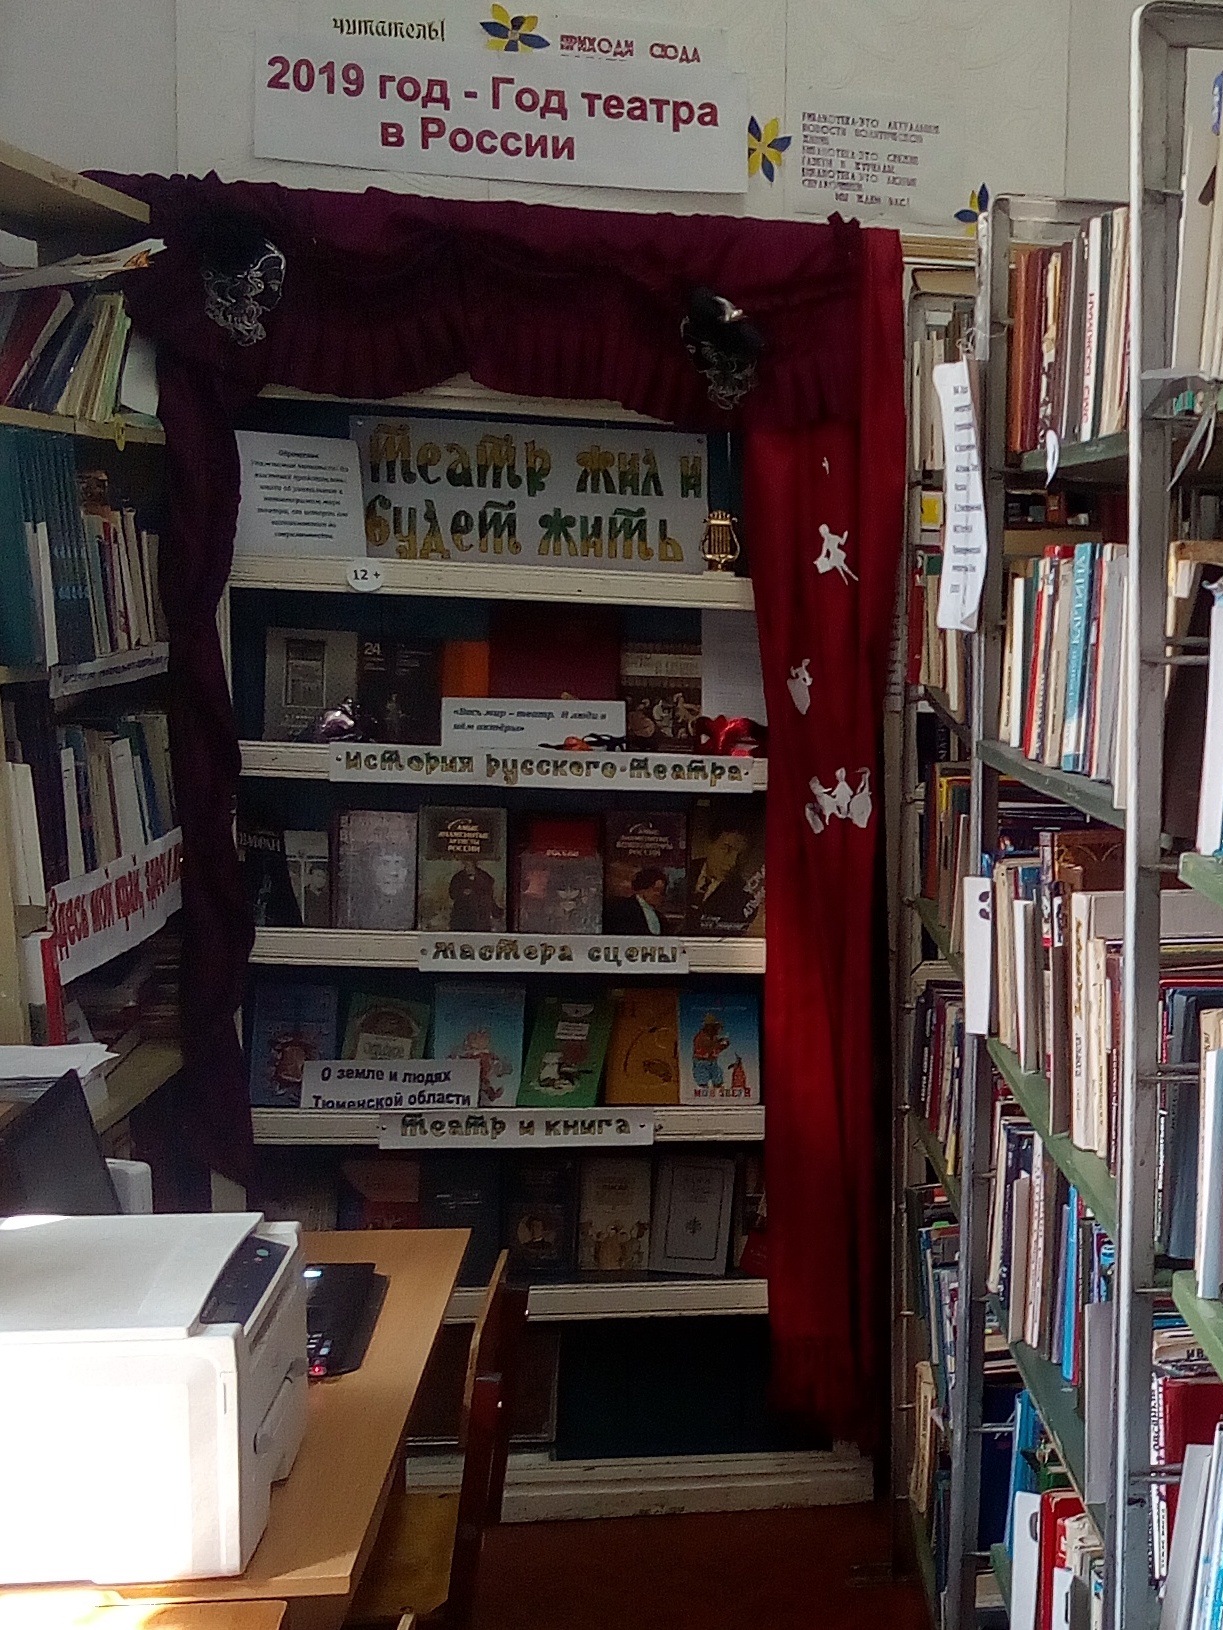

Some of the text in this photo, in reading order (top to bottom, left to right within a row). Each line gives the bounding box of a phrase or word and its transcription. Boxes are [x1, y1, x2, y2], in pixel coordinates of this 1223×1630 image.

[332, 17, 446, 42] читатель!
[560, 35, 701, 63] ПРИХОДИ СЮДА
[267, 56, 364, 97] 2019
[379, 73, 450, 110] год
[491, 77, 568, 120] Год
[581, 90, 719, 131] театра
[380, 117, 576, 161] в России
[345, 751, 744, 787] История русского театра
[432, 937, 679, 967] Мастера сцены
[321, 1068, 452, 1085] О земле и людях
[408, 1090, 472, 1108] области
[400, 1115, 632, 1141] Театр и книга
